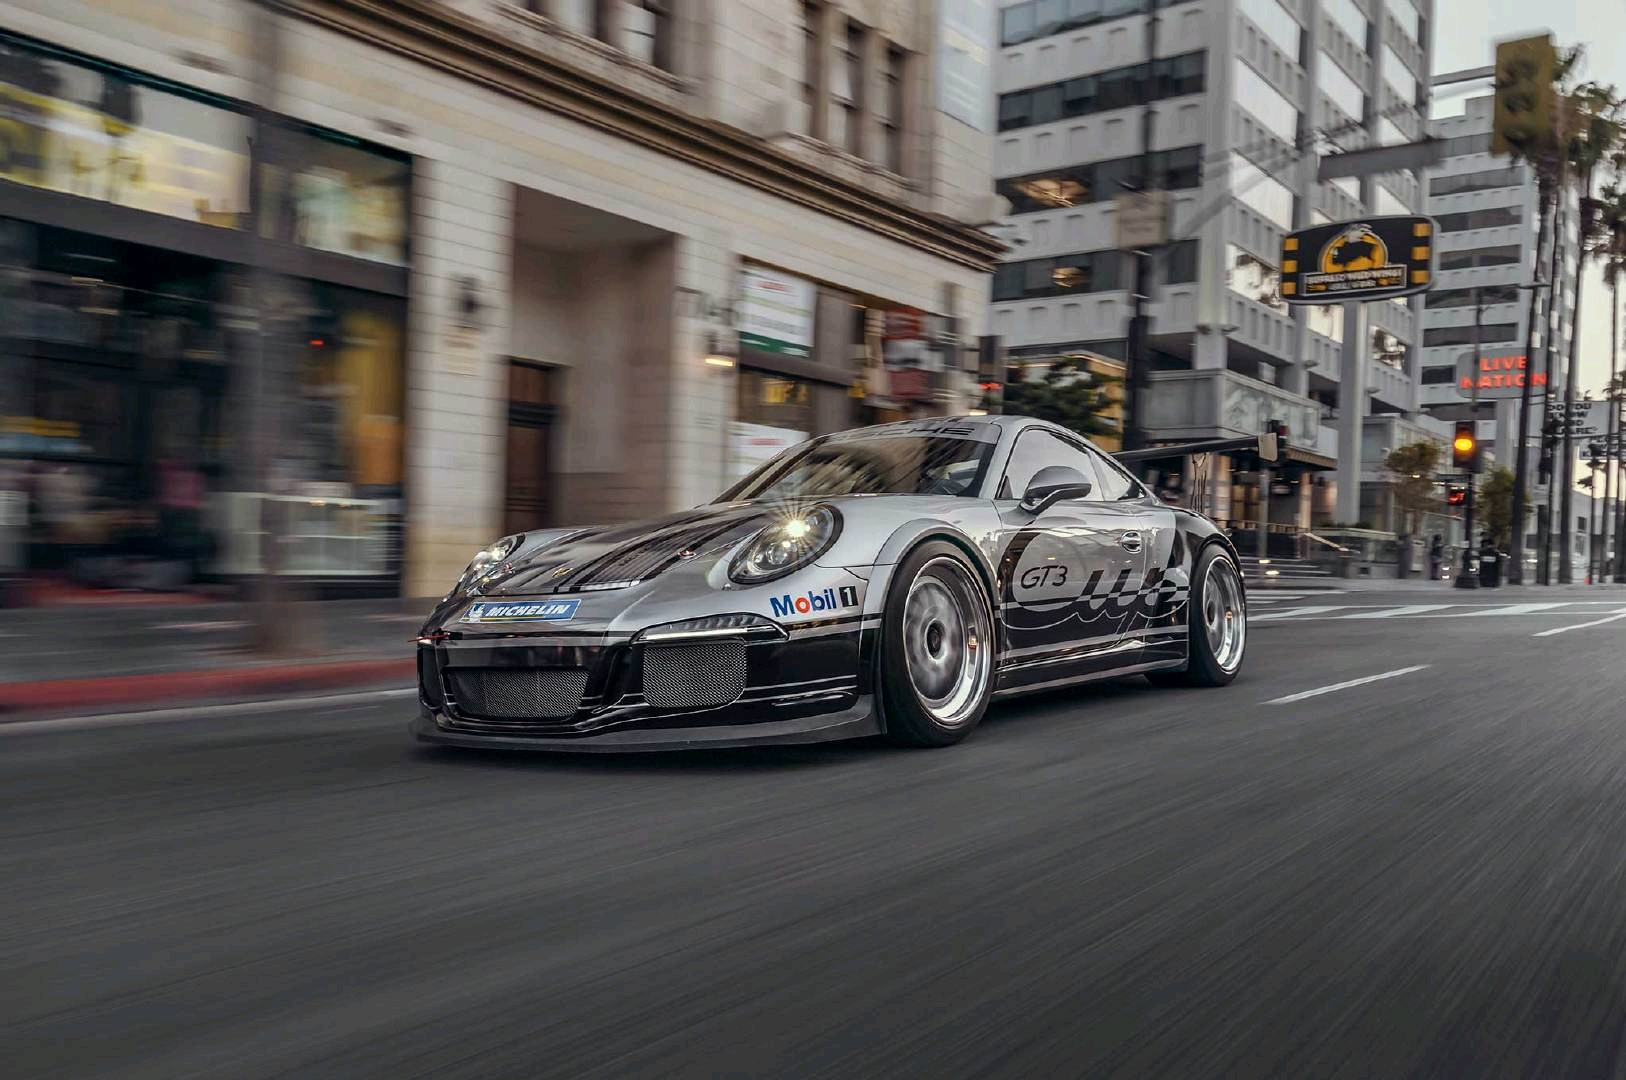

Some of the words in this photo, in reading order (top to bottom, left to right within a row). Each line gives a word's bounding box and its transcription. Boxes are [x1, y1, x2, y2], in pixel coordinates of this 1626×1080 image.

[1479, 356, 1527, 371] LIVE
[1020, 565, 1068, 590] GT3
[485, 604, 571, 617] MICHELIN
[769, 588, 837, 618] Mobil
